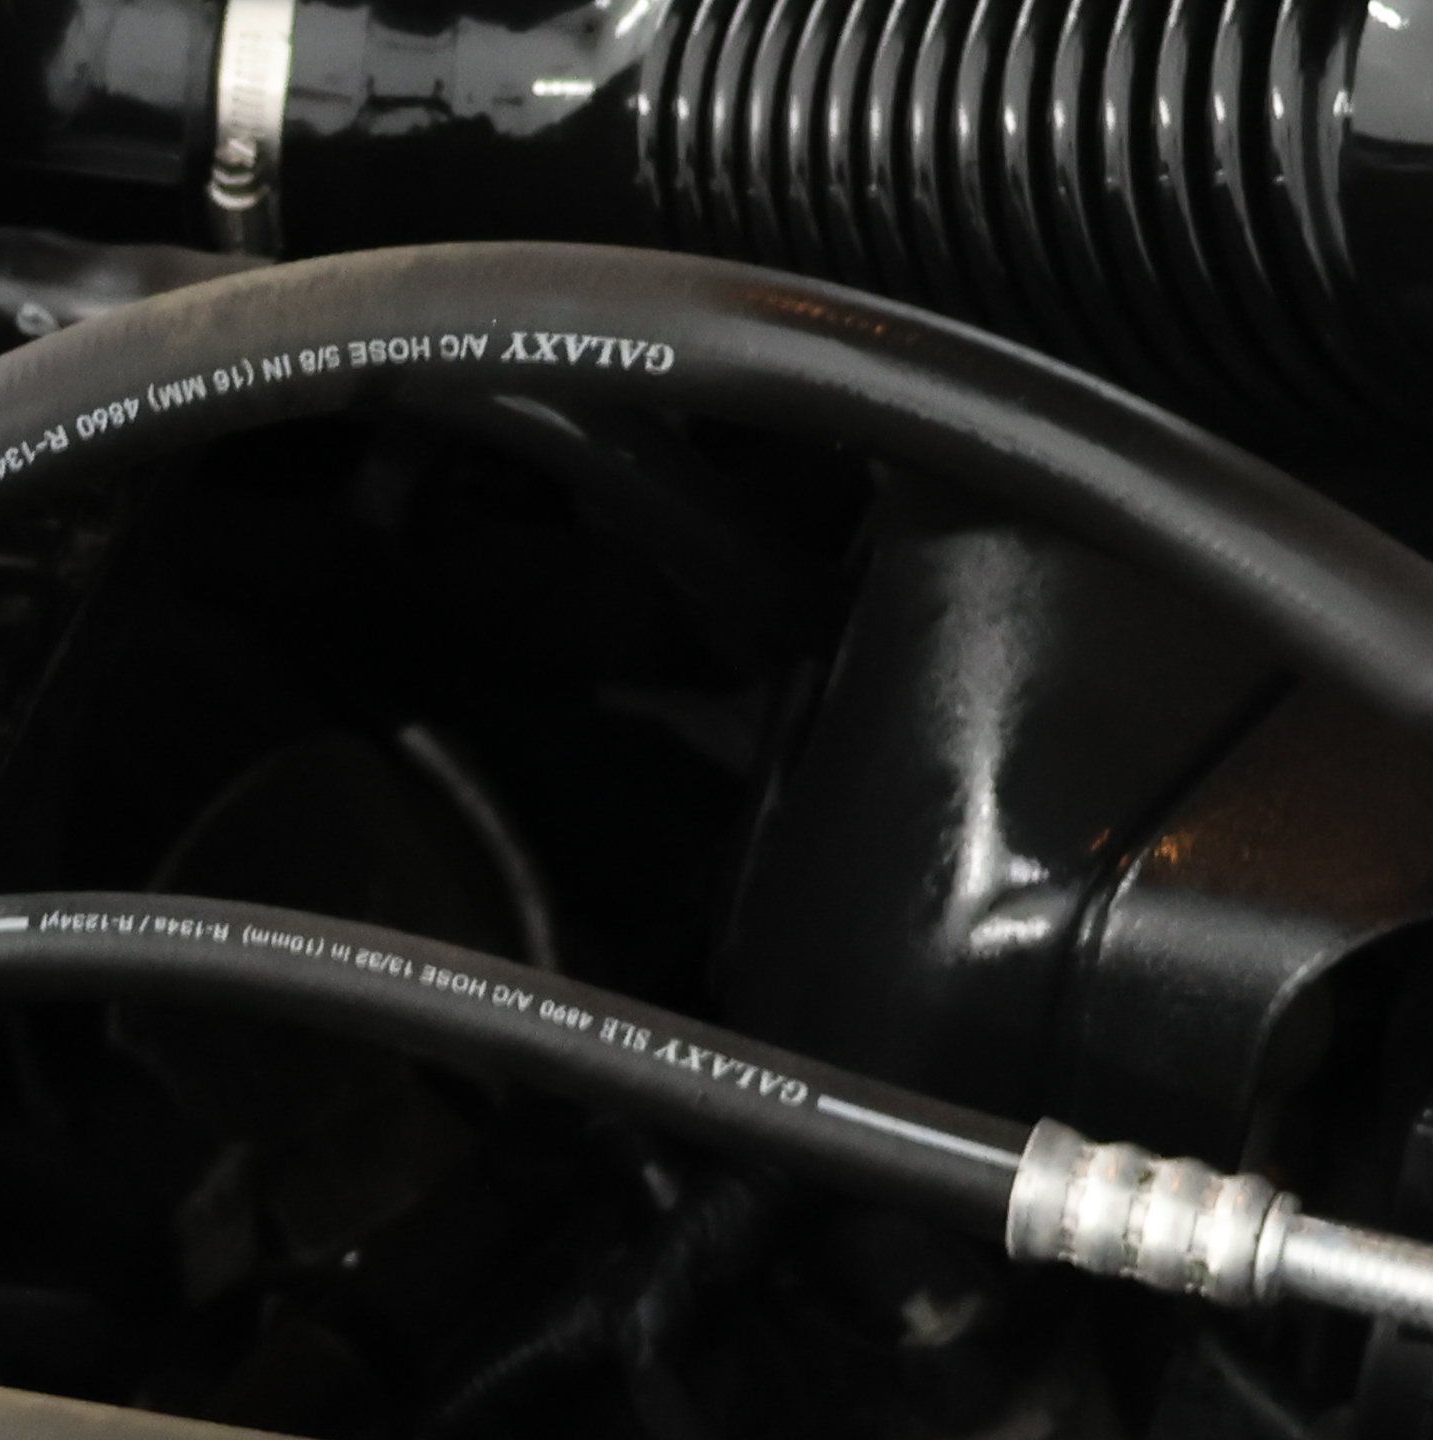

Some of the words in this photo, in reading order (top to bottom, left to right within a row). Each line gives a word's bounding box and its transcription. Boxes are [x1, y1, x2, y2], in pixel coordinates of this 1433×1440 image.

[298, 343, 341, 376] 5/8
[346, 335, 431, 368] HOSE
[439, 333, 489, 361] A/C
[500, 330, 676, 376] GALAXY
[211, 357, 255, 395] (16
[261, 352, 293, 383] IN
[146, 374, 208, 412] MM)
[75, 396, 140, 440] 4860
[419, 963, 488, 1000] HOSE
[492, 983, 534, 1012] A/C
[538, 999, 595, 1031] 4890
[598, 1016, 652, 1052] SLE
[653, 1037, 810, 1107] GALAXY
